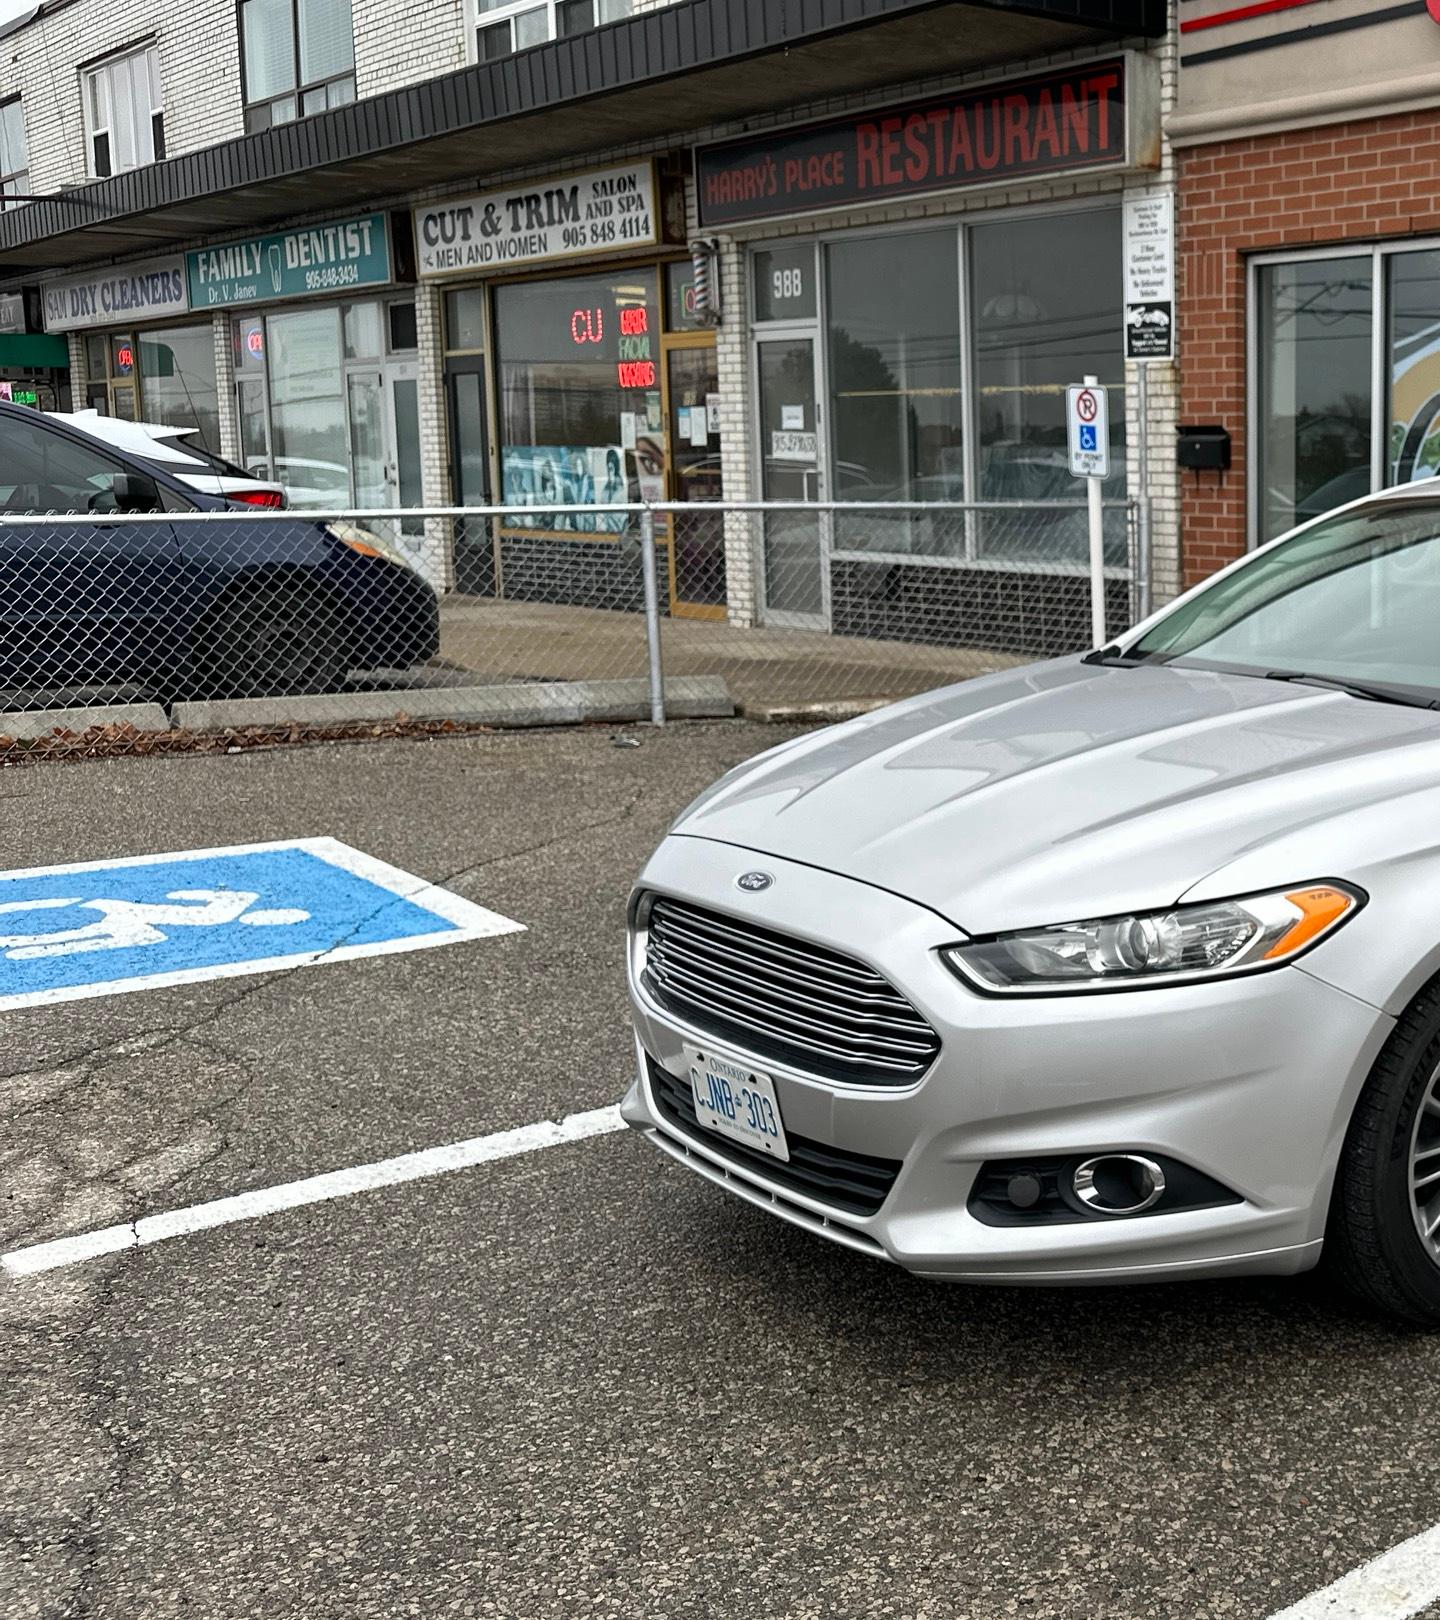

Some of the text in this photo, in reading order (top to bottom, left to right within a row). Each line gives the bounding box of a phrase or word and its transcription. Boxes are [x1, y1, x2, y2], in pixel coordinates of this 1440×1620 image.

[704, 74, 1119, 206] HARRY'S PLACE RESTAURANT
[592, 173, 637, 199] SALON
[423, 185, 581, 247] CUT & TRIM
[585, 193, 646, 221] AND SPA
[562, 214, 650, 249] 905 848 4114
[198, 220, 372, 284] FAMILY DENTIST
[436, 232, 548, 269] MEN AND WOMEN
[208, 287, 221, 304] Dr.
[222, 283, 232, 301] V.
[306, 264, 359, 290] 905-848-3434
[773, 268, 802, 298] 988
[48, 289, 68, 321] SAM
[70, 285, 98, 317] DRY
[101, 269, 183, 313] CLEANERS
[570, 308, 603, 344] CU
